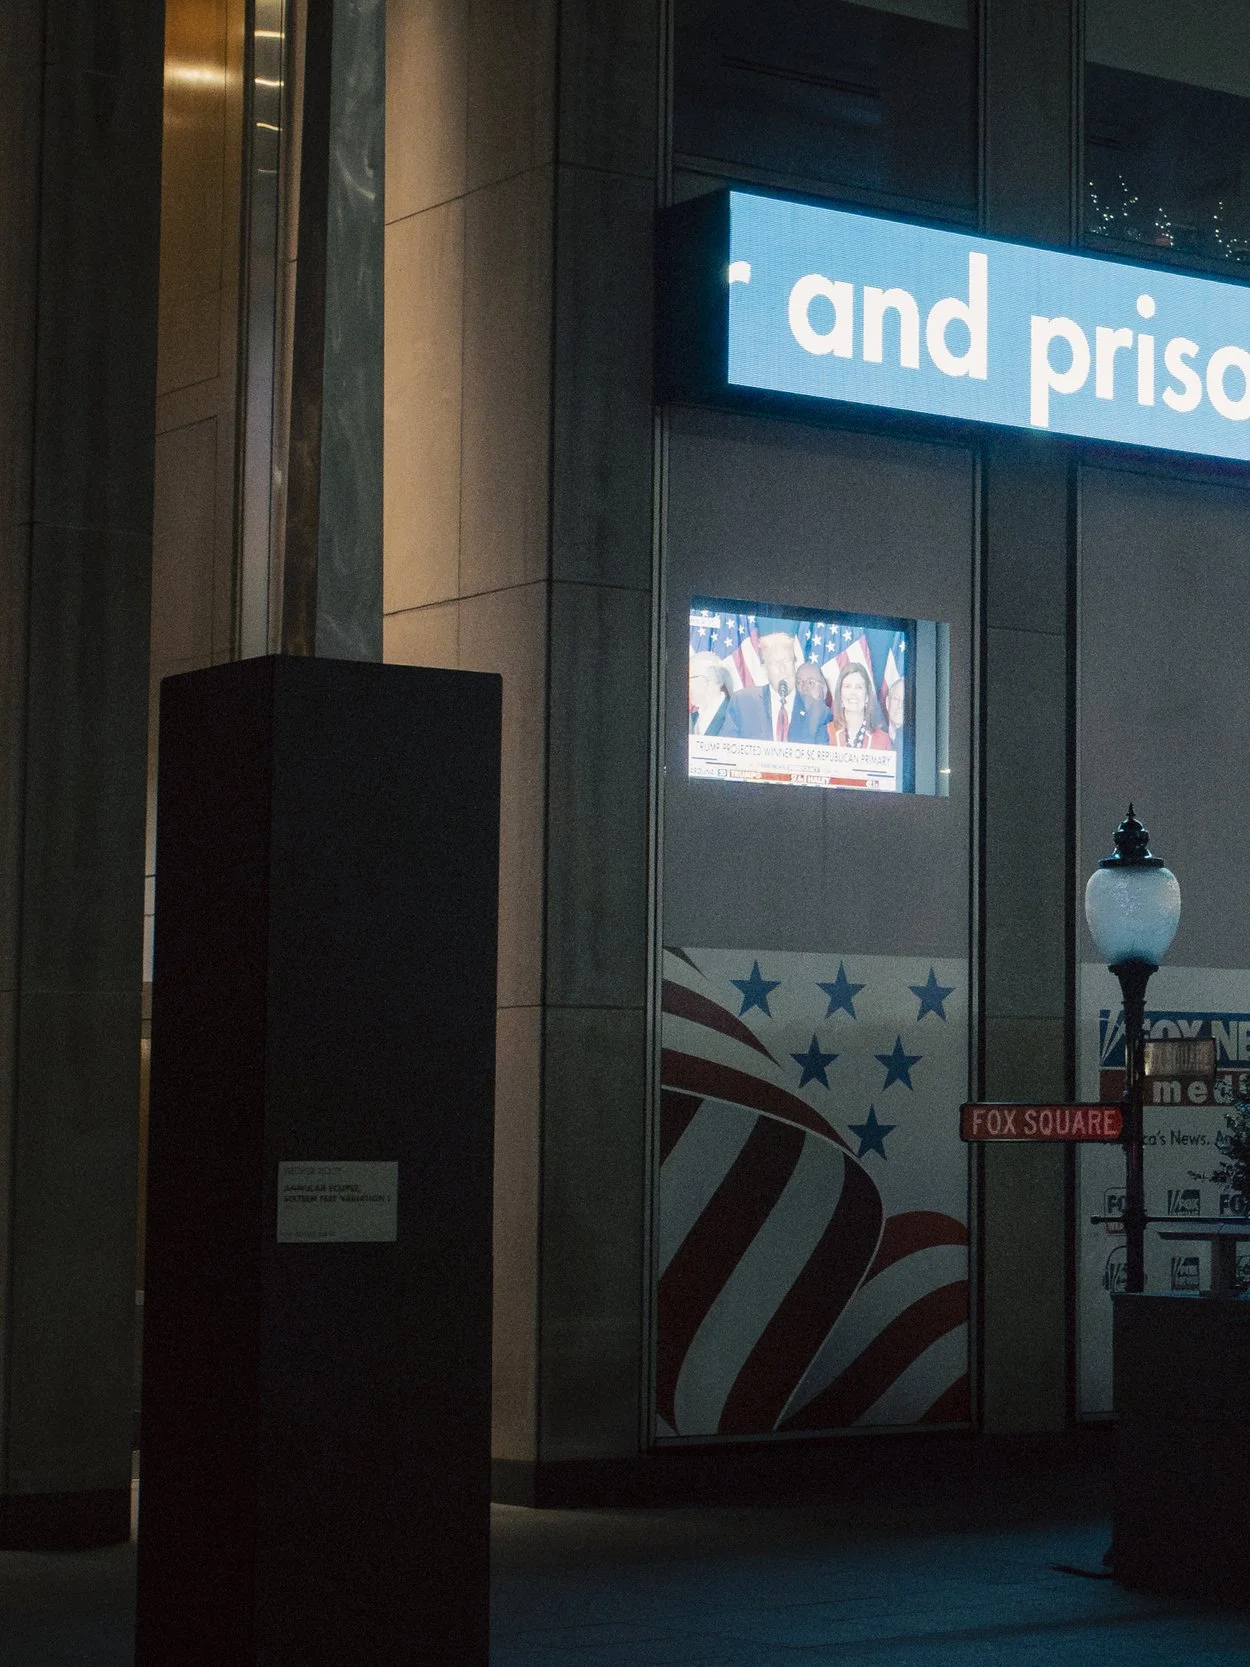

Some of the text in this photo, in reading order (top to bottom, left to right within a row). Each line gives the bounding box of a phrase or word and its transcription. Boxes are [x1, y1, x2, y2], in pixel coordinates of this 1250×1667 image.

[788, 251, 988, 380] and
[696, 740, 720, 752] TRUMP
[722, 743, 761, 755] PROJECTED
[763, 746, 793, 758] WINNER
[796, 749, 805, 760] OF
[817, 750, 858, 764] REPUBLICAN
[861, 754, 891, 767] PRIMARY
[972, 1109, 1119, 1136] FOX SQUARE
[1170, 1130, 1210, 1146] News.
